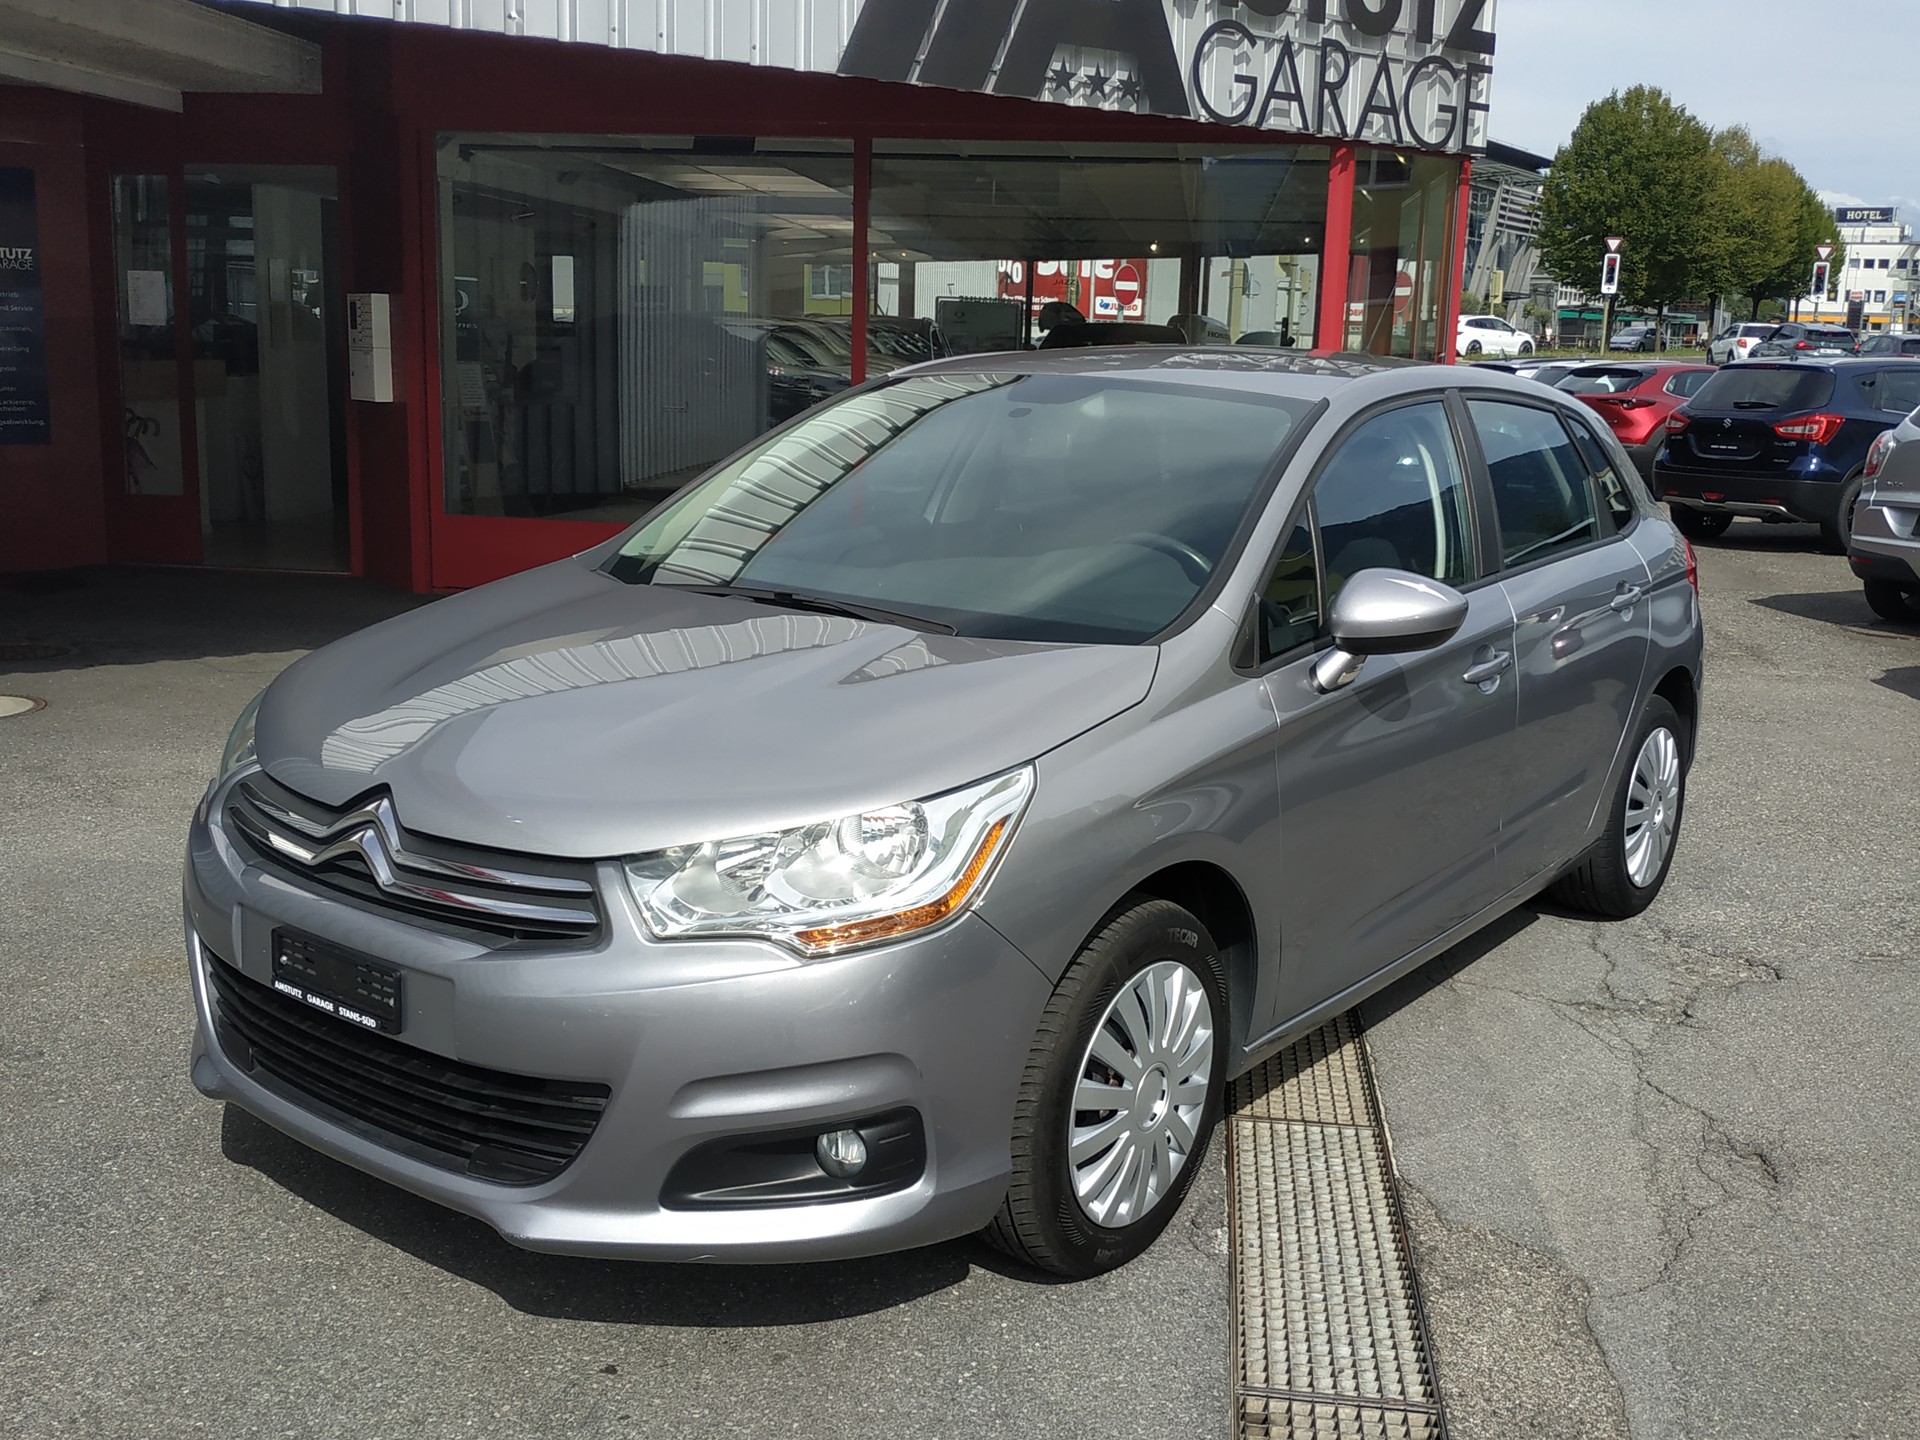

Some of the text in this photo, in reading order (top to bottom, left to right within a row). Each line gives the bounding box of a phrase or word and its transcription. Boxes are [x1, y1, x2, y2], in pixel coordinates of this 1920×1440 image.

[1192, 19, 1493, 156] GARAGE
[1846, 210, 1882, 220] HOTEL
[10, 304, 35, 312] Service
[1109, 303, 1138, 312] JUBO
[1167, 927, 1199, 949] TECAR
[274, 980, 377, 1028] AMSTUTZ GARAGE STANS-SÜD
